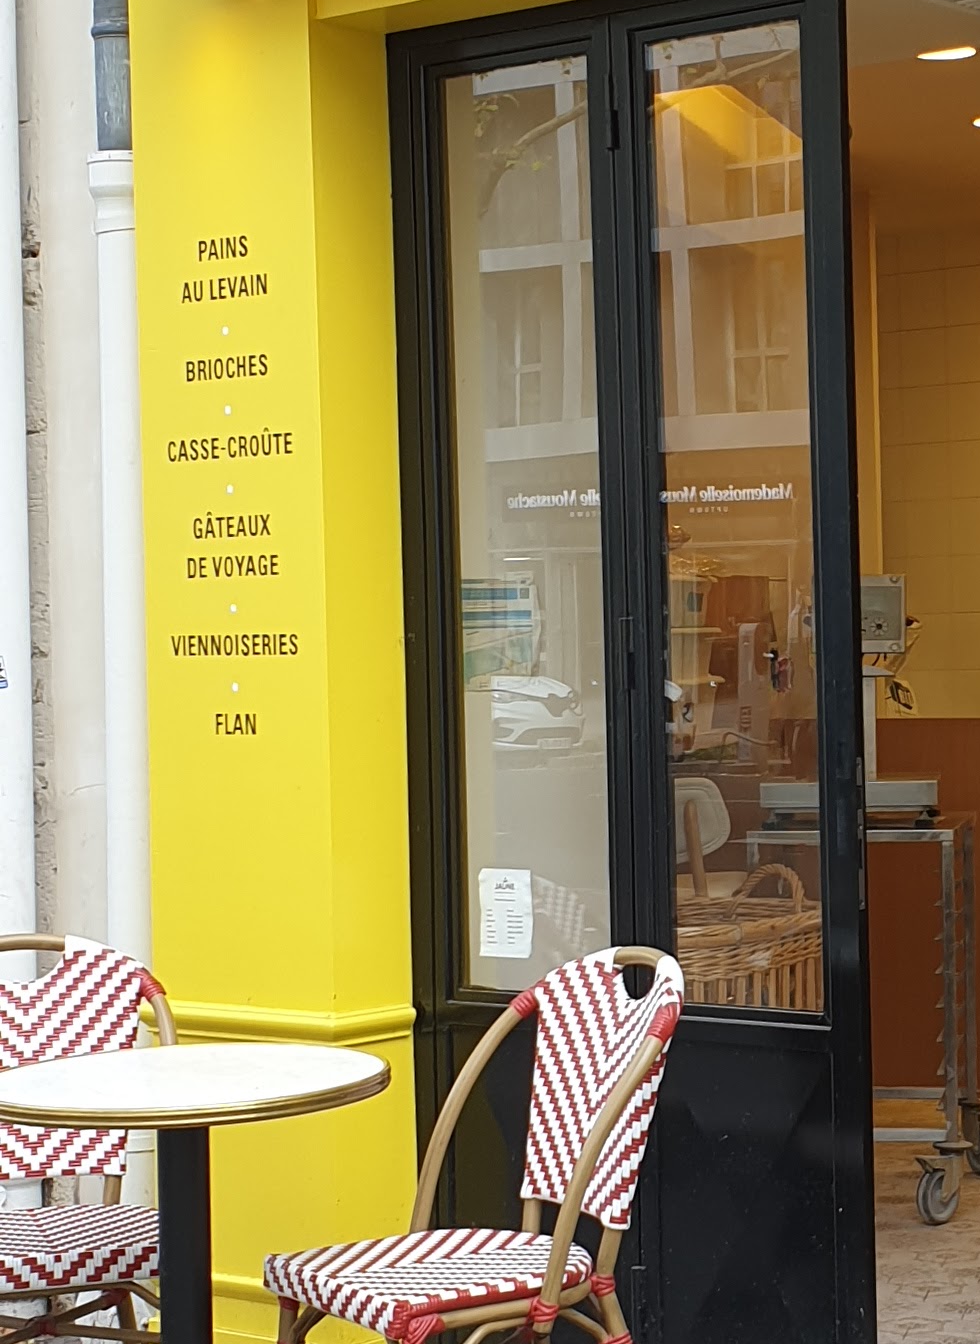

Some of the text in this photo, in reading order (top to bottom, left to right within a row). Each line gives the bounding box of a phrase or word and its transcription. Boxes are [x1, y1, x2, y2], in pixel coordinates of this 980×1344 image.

[197, 235, 249, 262] PAINS
[181, 273, 269, 304] AU LEVAIN
[185, 354, 269, 383] BRIOCHES
[167, 426, 294, 463] CASSE-CROÛTE
[192, 512, 272, 540] GÂTEAUX
[187, 555, 280, 579] DE VOYAGE
[170, 634, 299, 657] VIENNOISERIES
[215, 714, 257, 735] FLAN
